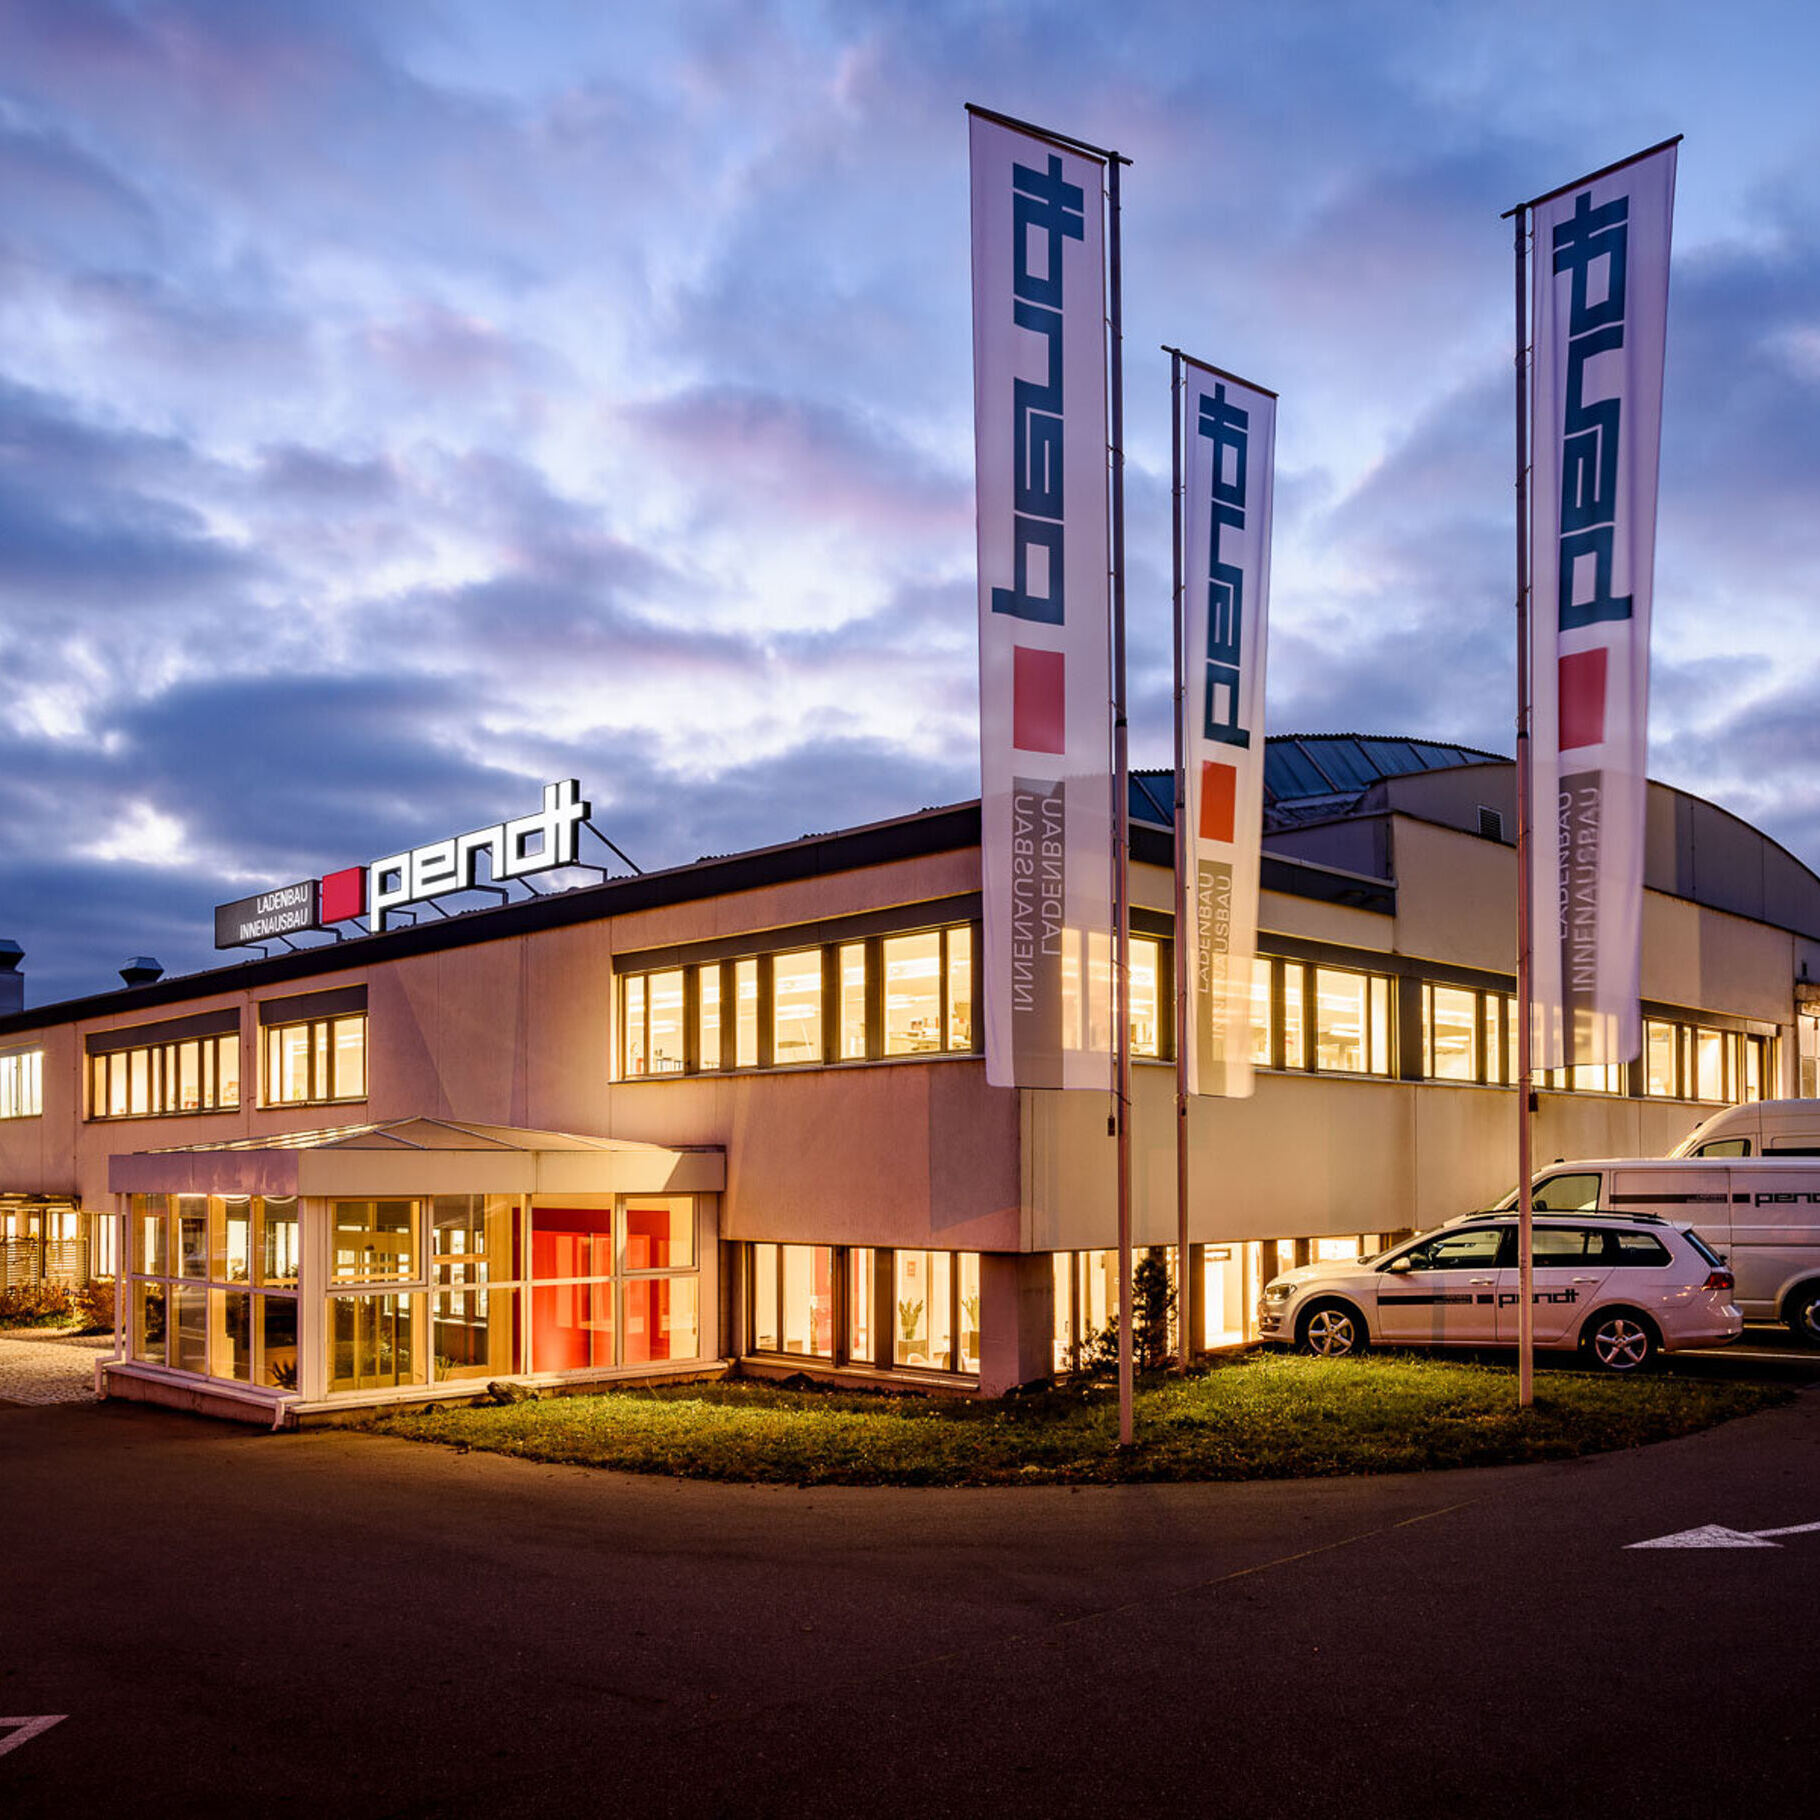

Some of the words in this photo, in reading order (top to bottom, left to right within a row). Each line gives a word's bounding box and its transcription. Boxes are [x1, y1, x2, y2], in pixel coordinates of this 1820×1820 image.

[1553, 190, 1633, 633] pendt
[1198, 382, 1250, 750] pendt
[240, 907, 309, 941] INNENAUSBAU
[256, 884, 309, 915] LADENBAU
[370, 778, 590, 932] pendt
[1571, 786, 1600, 993] INNENAUSBAU
[1198, 871, 1215, 994] LADENBAU
[1498, 1288, 1580, 1309] pndt
